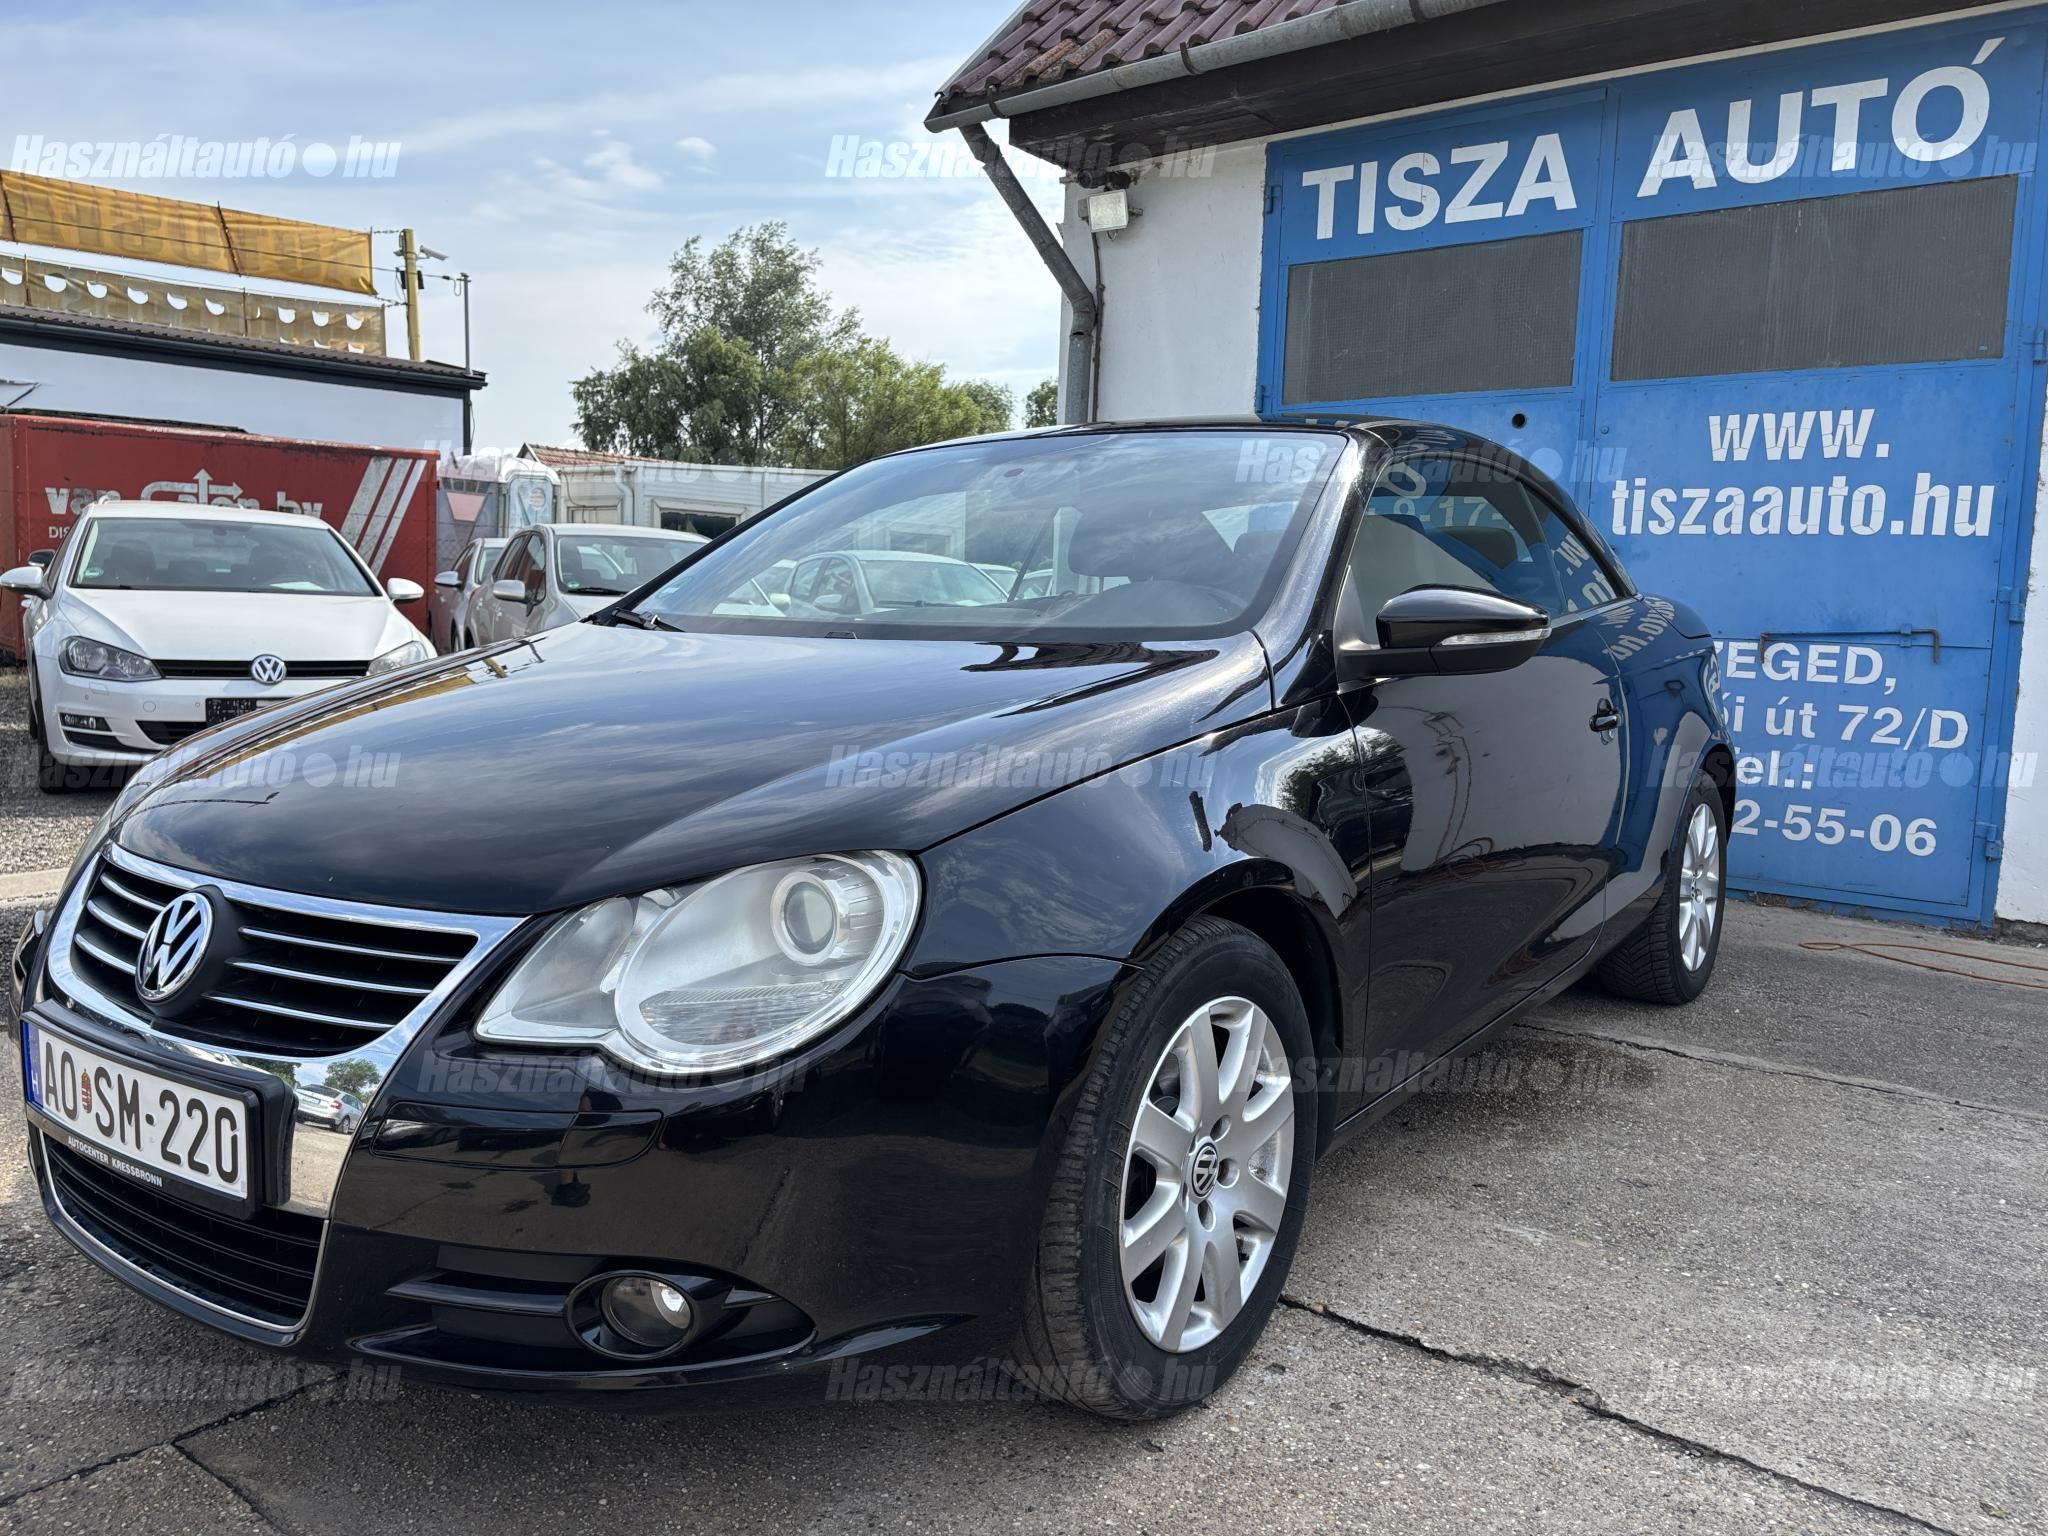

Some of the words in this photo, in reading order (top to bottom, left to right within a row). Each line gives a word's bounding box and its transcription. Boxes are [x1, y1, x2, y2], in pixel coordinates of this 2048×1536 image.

[1302, 132, 1577, 240] TISZA
[1637, 36, 2006, 198] AUTÓ
[1708, 408, 1891, 462] www.
[1611, 472, 1995, 537] tiszaauto.hu
[1765, 697, 1817, 738] út
[1838, 704, 1969, 751] 72/D
[1734, 746, 1814, 789] el.:
[1731, 798, 1937, 856] 2-55-06
[67, 1135, 109, 1165] AUTOCENTER
[111, 1158, 162, 1187] KRESSBRONN
